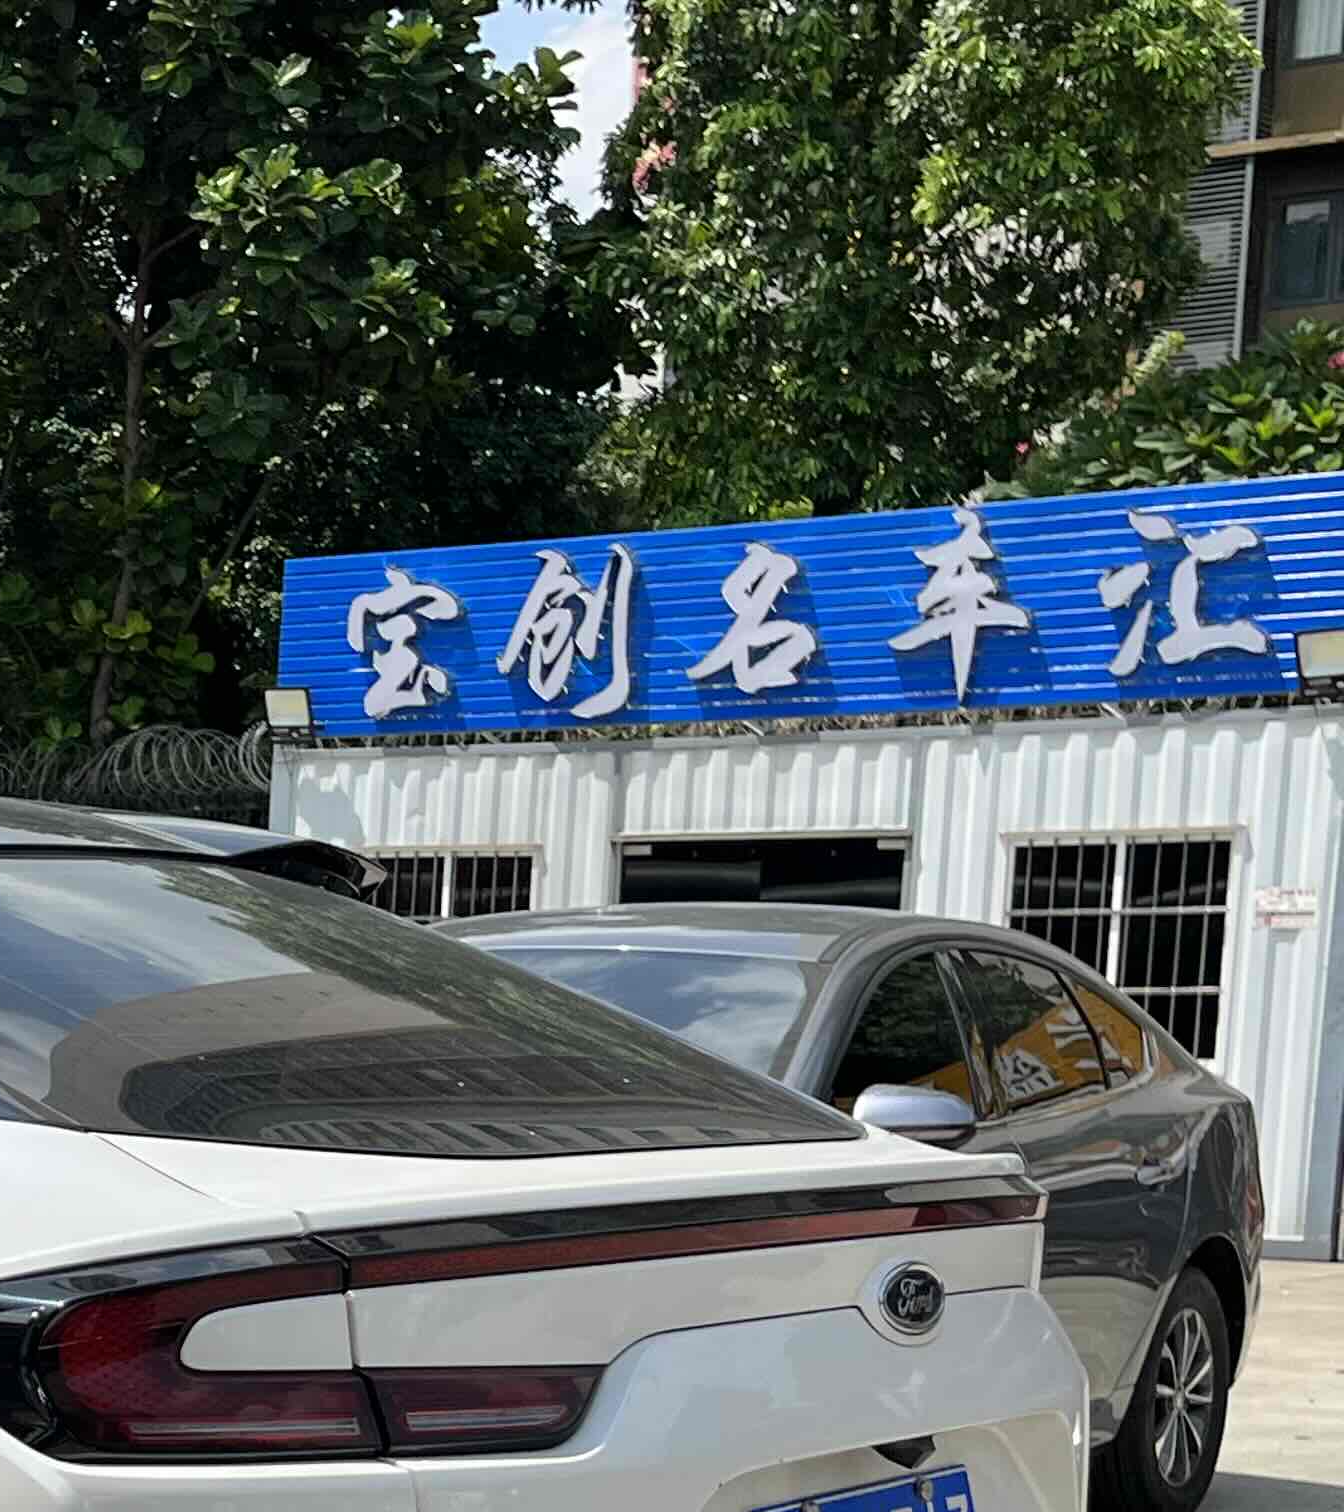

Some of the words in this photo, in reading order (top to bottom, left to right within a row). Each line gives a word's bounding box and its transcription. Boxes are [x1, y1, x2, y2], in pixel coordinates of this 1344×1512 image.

[346, 505, 1272, 719] 宝创名车汇
